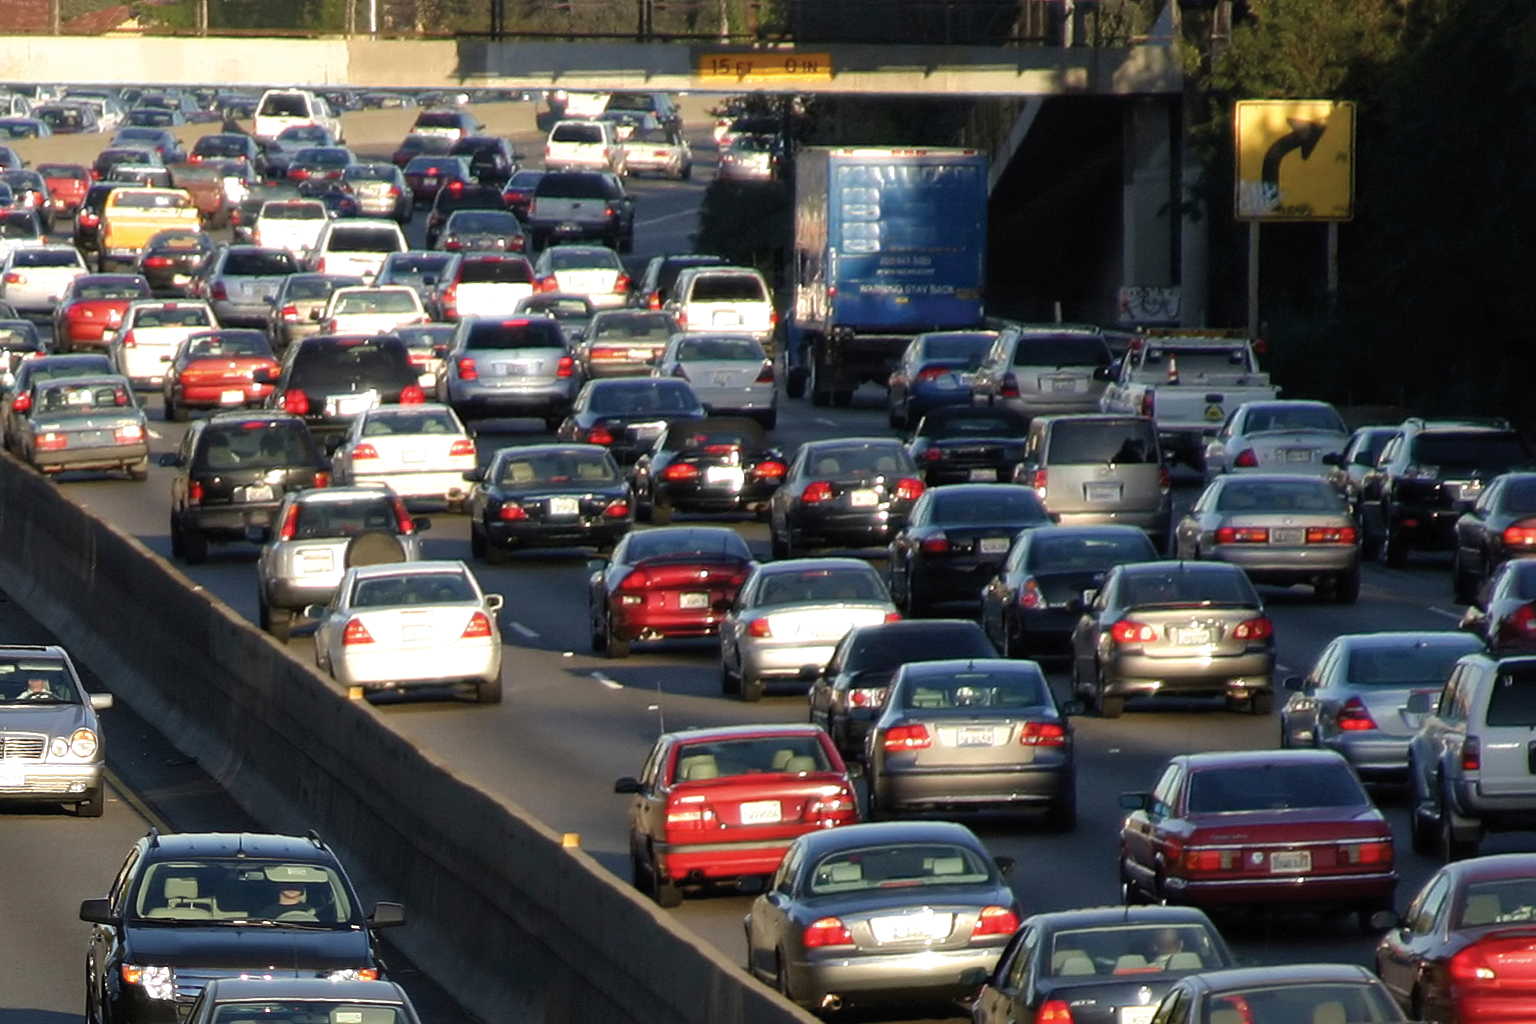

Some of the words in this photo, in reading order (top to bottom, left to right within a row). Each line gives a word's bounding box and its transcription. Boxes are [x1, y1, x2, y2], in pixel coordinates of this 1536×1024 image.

[711, 58, 730, 74] 15
[785, 58, 797, 73] 0
[803, 60, 818, 73] IN
[905, 284, 927, 294] STAY
